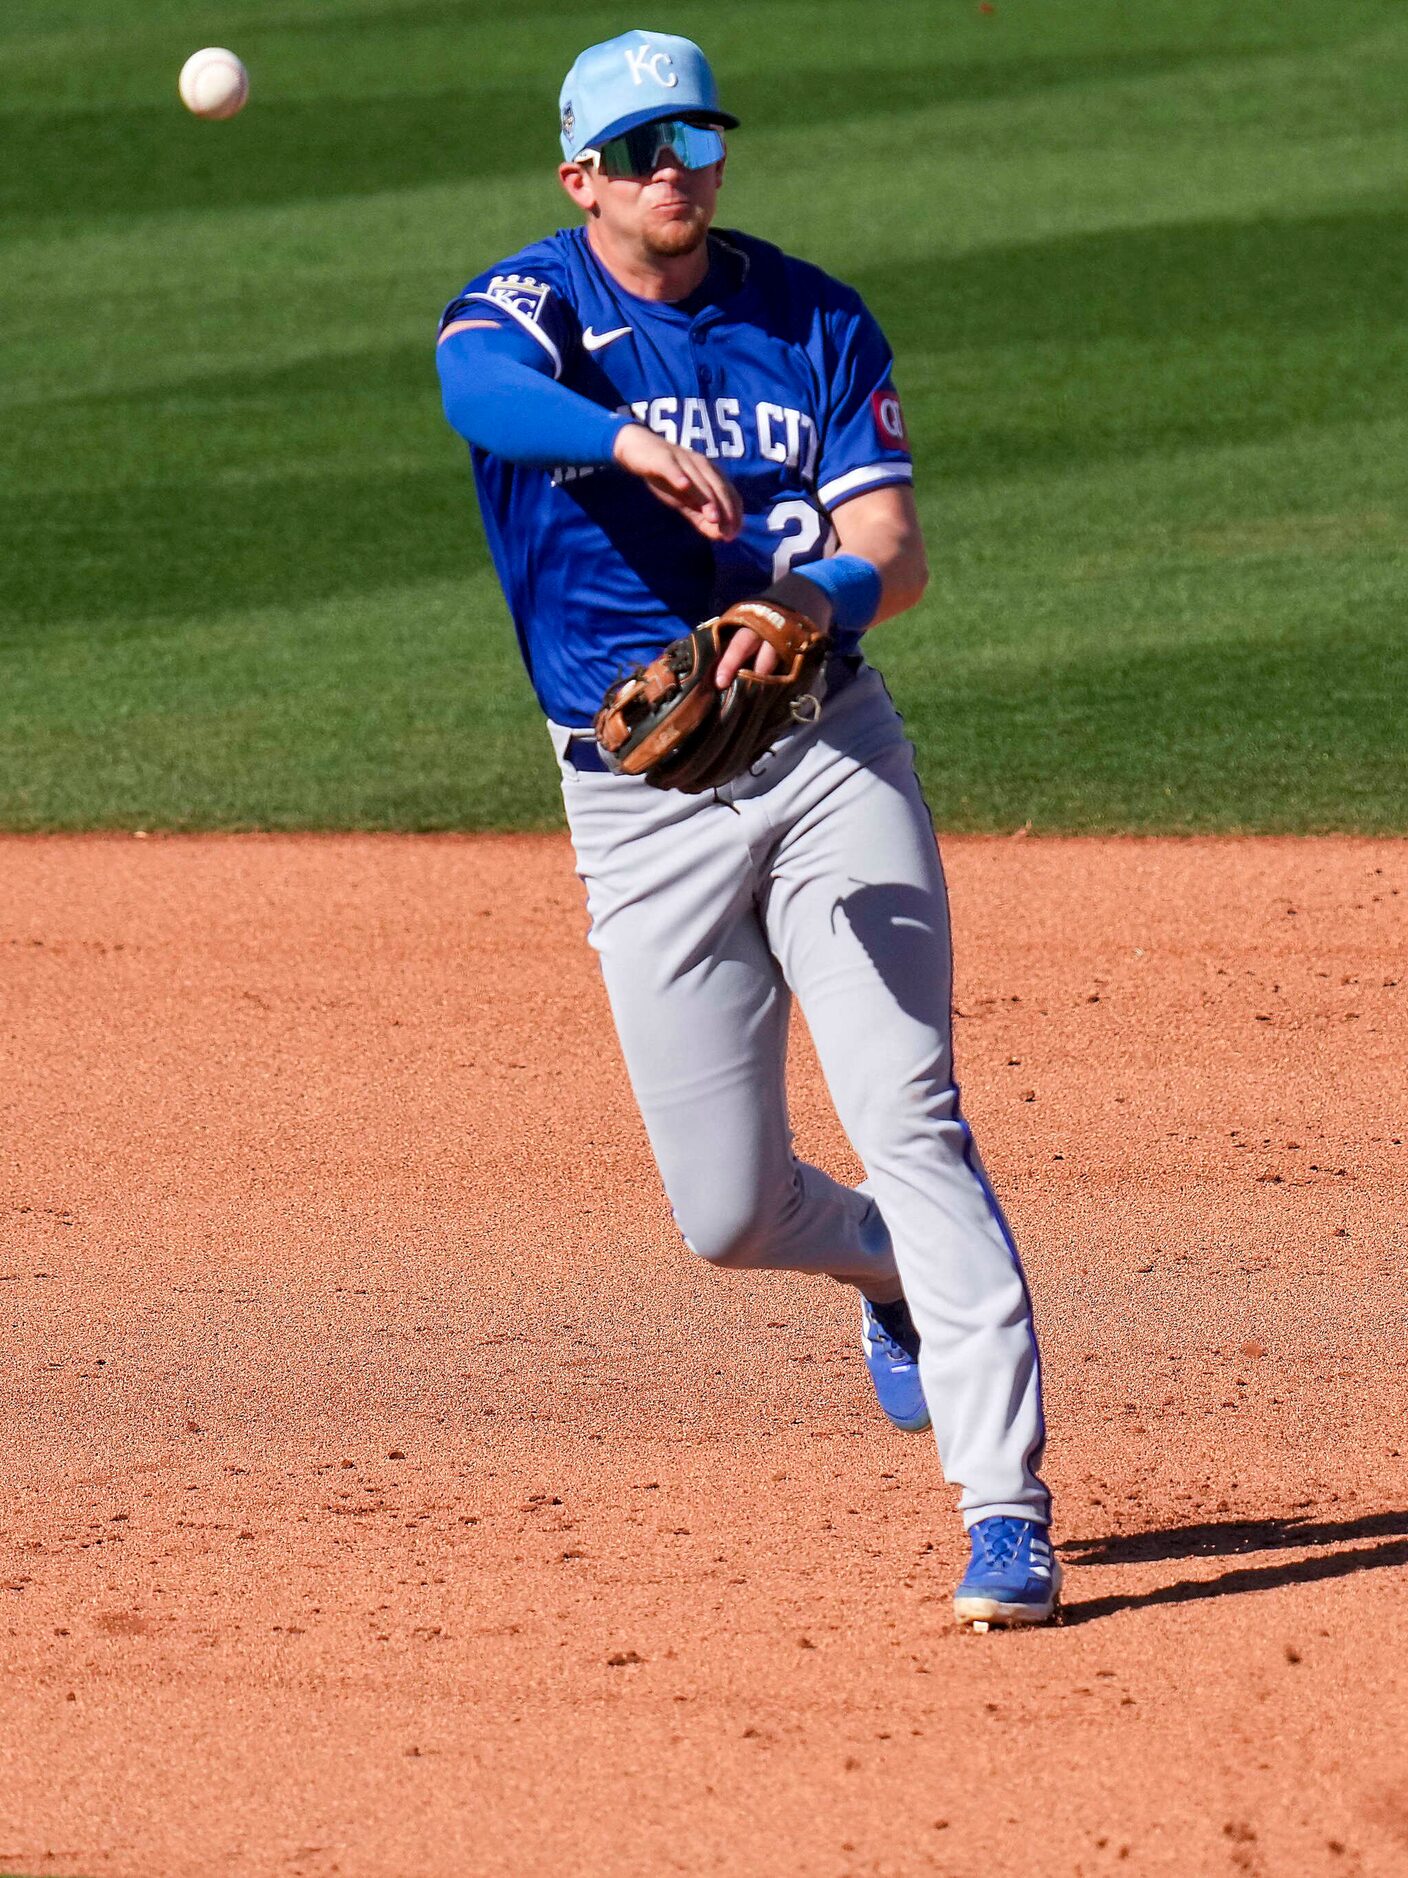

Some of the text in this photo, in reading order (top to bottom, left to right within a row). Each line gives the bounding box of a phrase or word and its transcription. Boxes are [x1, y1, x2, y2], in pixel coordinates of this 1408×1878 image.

[624, 44, 679, 88] KC
[755, 401, 819, 481] CIT
[766, 499, 837, 584] 2
